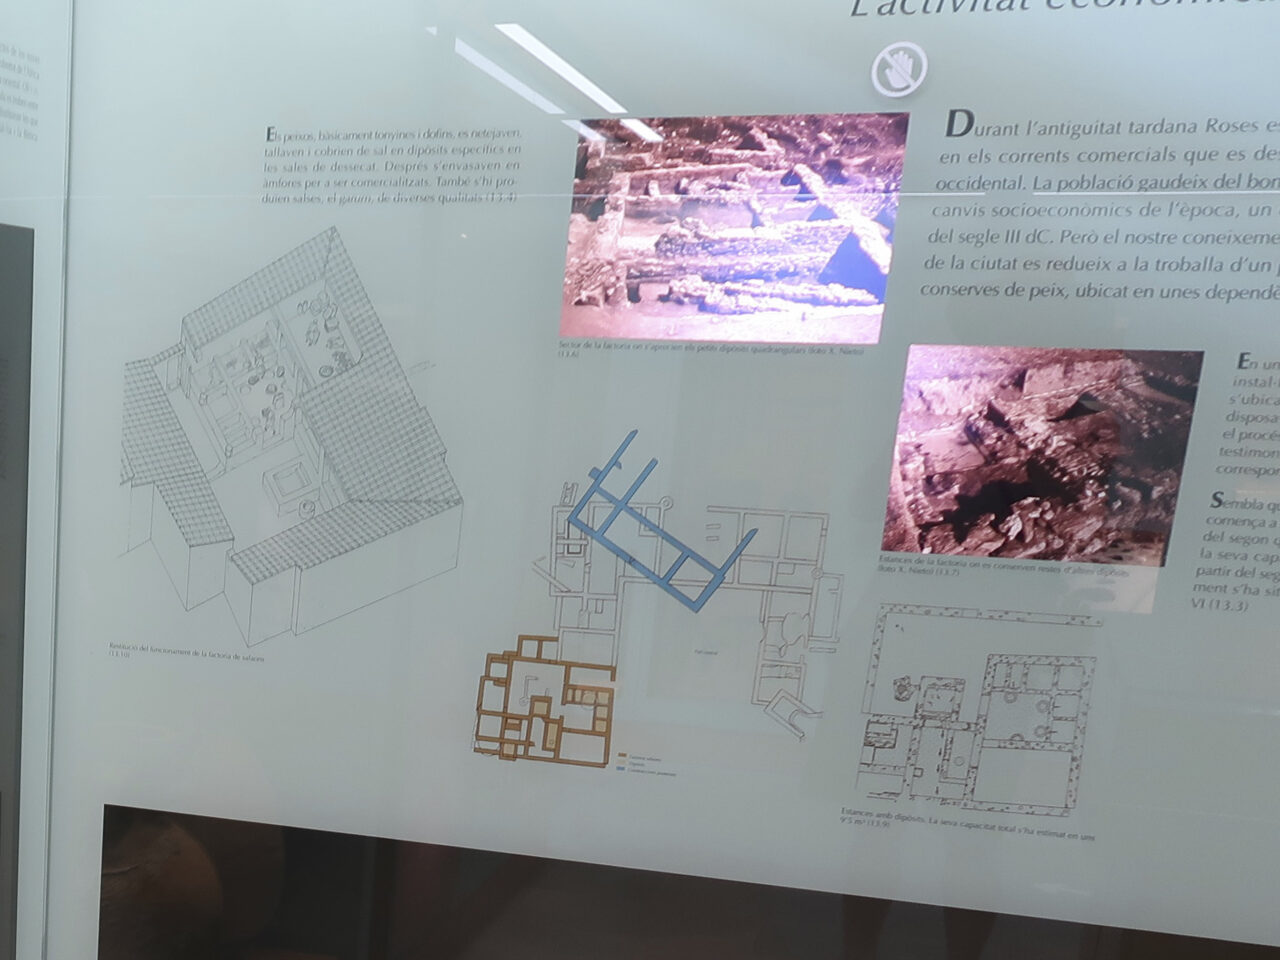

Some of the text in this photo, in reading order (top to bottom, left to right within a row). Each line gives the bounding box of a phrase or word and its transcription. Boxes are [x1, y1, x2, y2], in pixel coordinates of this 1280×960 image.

[945, 109, 1019, 138] Durant
[1026, 120, 1122, 141] l'antiguitat
[1128, 118, 1198, 135] tardana
[1205, 117, 1259, 133] Roses
[357, 145, 369, 156] de
[374, 145, 388, 156] sal
[390, 147, 403, 156] en
[507, 146, 521, 155] en
[939, 155, 960, 165] en
[968, 148, 992, 164] els
[998, 149, 1070, 164] corrents
[1077, 146, 1176, 163] comercials
[1183, 150, 1219, 166] que
[1226, 150, 1246, 162] es
[312, 161, 326, 172] de
[505, 161, 520, 170] en
[304, 179, 320, 190] per
[936, 175, 1026, 191] occidental.
[1033, 175, 1052, 190] La
[1057, 174, 1134, 193] població
[1138, 173, 1209, 193] gaudeix
[1213, 173, 1242, 189] del
[932, 202, 985, 217] canvis
[991, 201, 1132, 217] socioeconòmics
[1139, 201, 1161, 217] de
[1168, 201, 1239, 221] l'època,
[1248, 205, 1272, 217] un
[928, 228, 953, 243] del
[958, 228, 1000, 248] segle
[1005, 229, 1021, 243] III
[1025, 229, 1054, 244] dC.
[1059, 229, 1098, 244] Però
[1103, 229, 1119, 244] el
[1124, 231, 1178, 245] nostre
[924, 255, 945, 270] de
[950, 255, 965, 270] la
[971, 256, 1018, 270] ciutat
[1023, 259, 1041, 271] es
[1046, 255, 1111, 272] redueix
[1117, 259, 1127, 271] a
[1134, 256, 1149, 271] la
[1155, 256, 1224, 272] troballa
[1230, 256, 1272, 272] d'un
[920, 284, 1000, 297] conserves
[1004, 282, 1025, 297] de
[1029, 283, 1069, 301] peix,
[1075, 283, 1127, 298] ubicat
[1133, 287, 1154, 298] en
[1160, 287, 1200, 298] unes
[1237, 352, 1258, 370] En
[1222, 428, 1236, 440] el
[1210, 491, 1264, 511] Sembla
[1206, 516, 1266, 530] comença
[1203, 530, 1225, 543] del
[1230, 534, 1269, 547] segon
[1200, 547, 1212, 560] la
[1218, 551, 1248, 561] seva
[1195, 566, 1231, 578] partir
[1234, 566, 1256, 578] del
[1193, 583, 1228, 594] ment
[1192, 598, 1206, 609] VI
